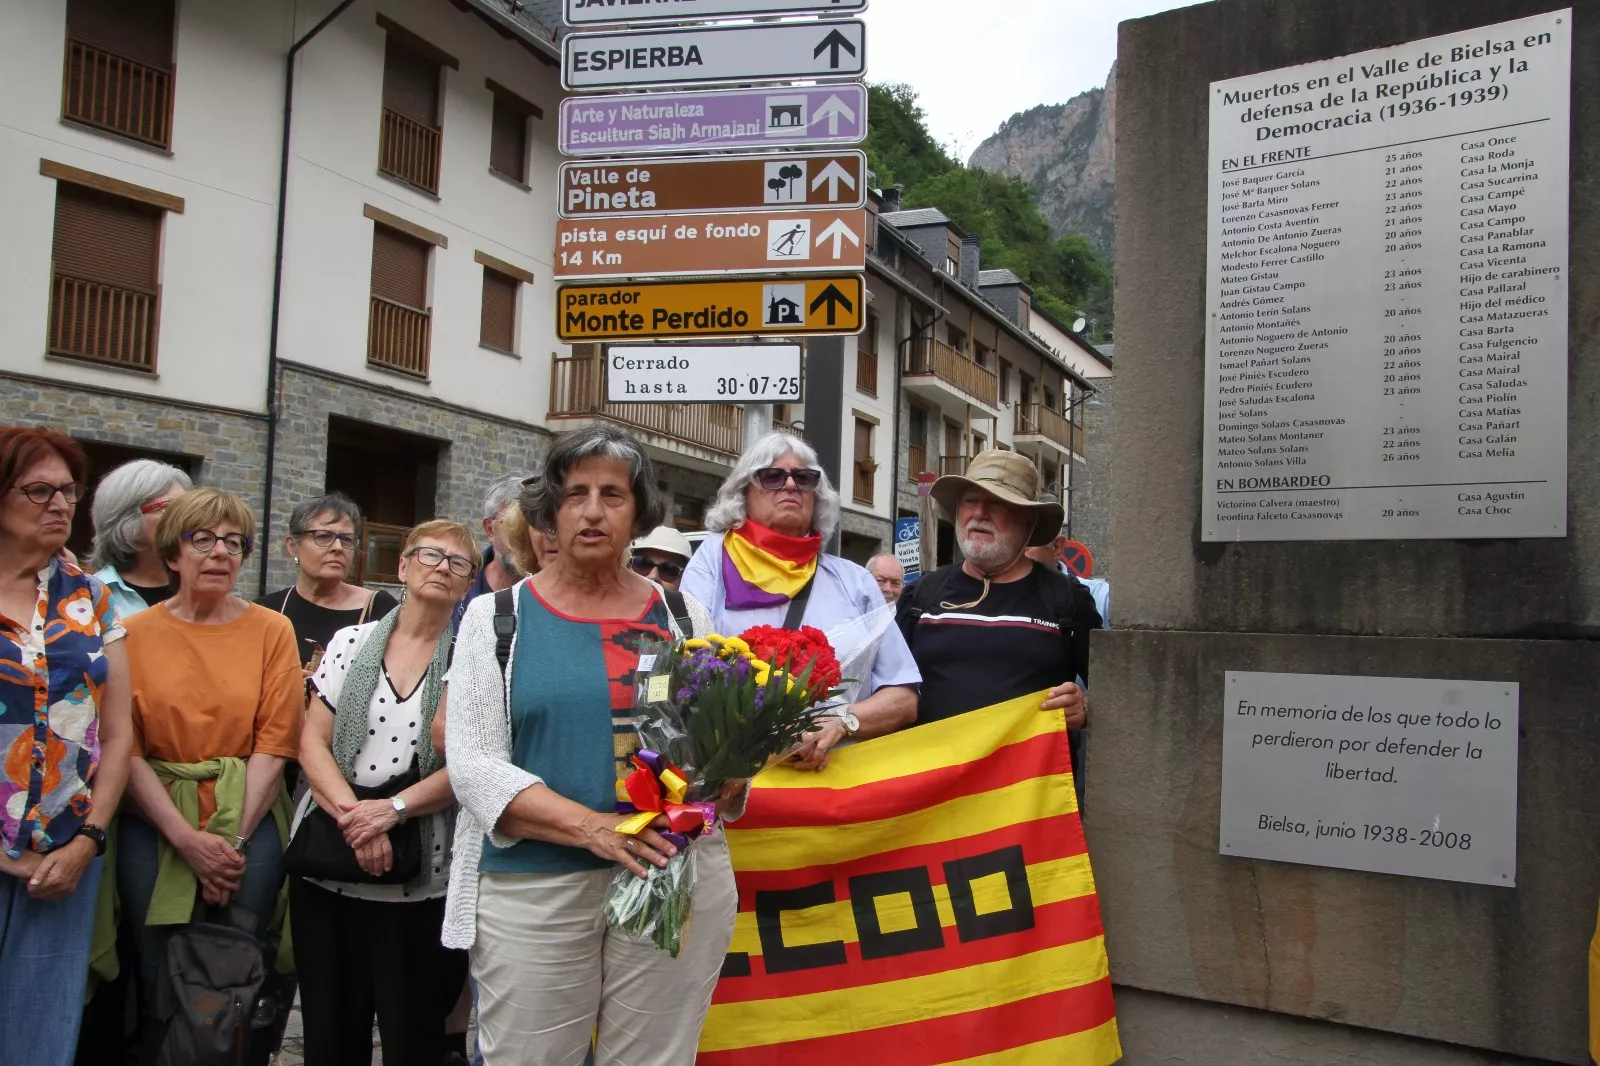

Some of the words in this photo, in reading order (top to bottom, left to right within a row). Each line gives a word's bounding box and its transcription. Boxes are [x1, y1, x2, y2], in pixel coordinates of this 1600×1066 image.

[574, 45, 703, 72] ESPIERBA
[1223, 82, 1299, 105] Muertos
[1306, 76, 1329, 90] en
[1336, 66, 1353, 84] el
[1360, 58, 1409, 79] Valle
[1416, 51, 1442, 69] de
[1450, 39, 1515, 62] Bielsa
[1523, 32, 1551, 47] en
[1240, 101, 1314, 123] defensa
[1320, 92, 1344, 108] de
[1351, 87, 1368, 103] la
[1376, 68, 1482, 99] República
[1489, 65, 1501, 83] y
[1509, 57, 1528, 73] la
[572, 108, 604, 123] Arte
[608, 109, 617, 125] y
[622, 103, 704, 120] Naturaleza
[1256, 108, 1372, 141] Democracia
[1379, 83, 1508, 121] (1936-1939)
[571, 128, 643, 143] Escultura
[648, 123, 686, 144] Siajh
[690, 119, 760, 139] Armajani
[1460, 141, 1485, 150] Casa
[1487, 136, 1516, 146] Once
[1222, 157, 1238, 170] EN
[1243, 155, 1257, 166] EL
[1261, 145, 1310, 163] FRENTE
[1385, 153, 1396, 162] 25
[1399, 151, 1422, 160] años
[1460, 154, 1484, 163] Casa
[1488, 148, 1514, 159] Roda
[1460, 168, 1484, 177] Casa
[1487, 164, 1497, 173] la
[1500, 158, 1534, 171] Monja
[570, 169, 619, 185] Valle
[626, 168, 650, 183] de
[1222, 177, 1239, 189] José
[1242, 174, 1273, 185] Baquer
[1275, 168, 1304, 179] García
[1460, 181, 1484, 190] Casa
[1487, 172, 1538, 186] Sucarrina
[569, 187, 657, 211] Pineta
[1460, 194, 1484, 203] Casa
[1487, 186, 1525, 199] Campé
[1221, 214, 1256, 223] Lorenzo
[1311, 201, 1339, 211] Ferrer
[1460, 208, 1484, 216] Casa
[1487, 203, 1516, 214] Mayo
[1460, 221, 1484, 230] Casa
[1487, 215, 1525, 226] Campo
[562, 228, 607, 246] pista
[616, 225, 667, 244] esquí
[675, 225, 697, 239] de
[705, 223, 760, 238] fondo
[1460, 234, 1483, 243] Casa
[1487, 227, 1534, 240] Panablar
[1460, 248, 1484, 256] Casa
[1487, 245, 1499, 253] La
[1502, 240, 1546, 252] Ramona
[561, 251, 582, 266] 14
[593, 250, 621, 265] Km
[1220, 261, 1258, 272] Modesto
[1260, 259, 1287, 267] Ferrer
[1290, 252, 1324, 263] Castillo
[1459, 261, 1484, 270] Casa
[1486, 255, 1526, 266] Vicenta
[1460, 273, 1481, 284] Hijo
[1484, 271, 1498, 280] de
[1501, 266, 1560, 278] carabinero
[1384, 282, 1395, 291] 23
[1398, 280, 1421, 289] años
[1459, 288, 1484, 296] Casa
[1487, 281, 1526, 293] Pallaral
[566, 290, 640, 306] parador
[1219, 298, 1250, 309] Andrés
[1252, 296, 1284, 305] Gómez
[1460, 300, 1481, 311] Hijo
[1484, 297, 1501, 308] del
[1504, 294, 1545, 306] médico
[566, 309, 644, 332] Monte
[653, 305, 748, 329] Perdido
[1459, 315, 1483, 323] Casa
[1486, 309, 1548, 321] Matazueras
[1219, 334, 1254, 345] Antonio
[1256, 332, 1294, 343] Noguero
[1297, 329, 1308, 338] de
[1311, 326, 1348, 336] Antonio
[1459, 328, 1483, 336] Casa
[1486, 325, 1514, 334] Barta
[1459, 341, 1483, 350] Casa
[1486, 336, 1537, 349] Fulgencio
[613, 355, 689, 369] Cerrado
[1459, 355, 1483, 363] Casa
[1486, 350, 1519, 361] Mairal
[1458, 368, 1483, 377] Casa
[1486, 364, 1520, 375] Mairal
[625, 380, 687, 393] hasta
[1458, 382, 1483, 390] Casa
[1486, 378, 1527, 389] Saludas
[1218, 397, 1236, 408] José
[1239, 395, 1272, 405] Saludas
[1275, 393, 1314, 402] Escalona
[1458, 395, 1482, 404] Casa
[1486, 392, 1516, 402] Piolín
[1458, 409, 1483, 417] Casa
[1485, 405, 1521, 416] Matías
[1458, 422, 1483, 431] Casa
[1486, 420, 1519, 429] Pañart
[1217, 435, 1245, 443] Mateo
[1247, 433, 1276, 442] Solans
[1279, 432, 1324, 440] Montaner
[1458, 436, 1482, 445] Casa
[1485, 433, 1516, 443] Galán
[1382, 453, 1394, 461] 26
[1397, 452, 1420, 460] años
[1458, 449, 1482, 458] Casa
[1485, 447, 1515, 457] Melia
[1216, 478, 1233, 490] EN
[1238, 474, 1330, 489] BOMBARDEO
[1457, 492, 1481, 501] Casa
[1484, 490, 1524, 503] Agustín
[1457, 506, 1482, 515] Casa
[1485, 505, 1511, 514] Choc
[898, 548, 914, 556] Valle
[1238, 701, 1256, 715] En
[1261, 705, 1336, 720] memoria
[1342, 705, 1363, 721] de
[1368, 706, 1391, 723] los
[1397, 714, 1430, 728] que
[1436, 711, 1479, 728] todo
[1485, 712, 1501, 729] lo
[1252, 731, 1333, 748] perdieron
[1339, 740, 1370, 754] por
[1376, 737, 1460, 757] defender
[1466, 742, 1482, 759] la
[1326, 762, 1397, 783] libertad.
[1259, 815, 1309, 836] Bielsa,
[1316, 820, 1355, 839] junio
[1364, 825, 1471, 850] 1938-2008
